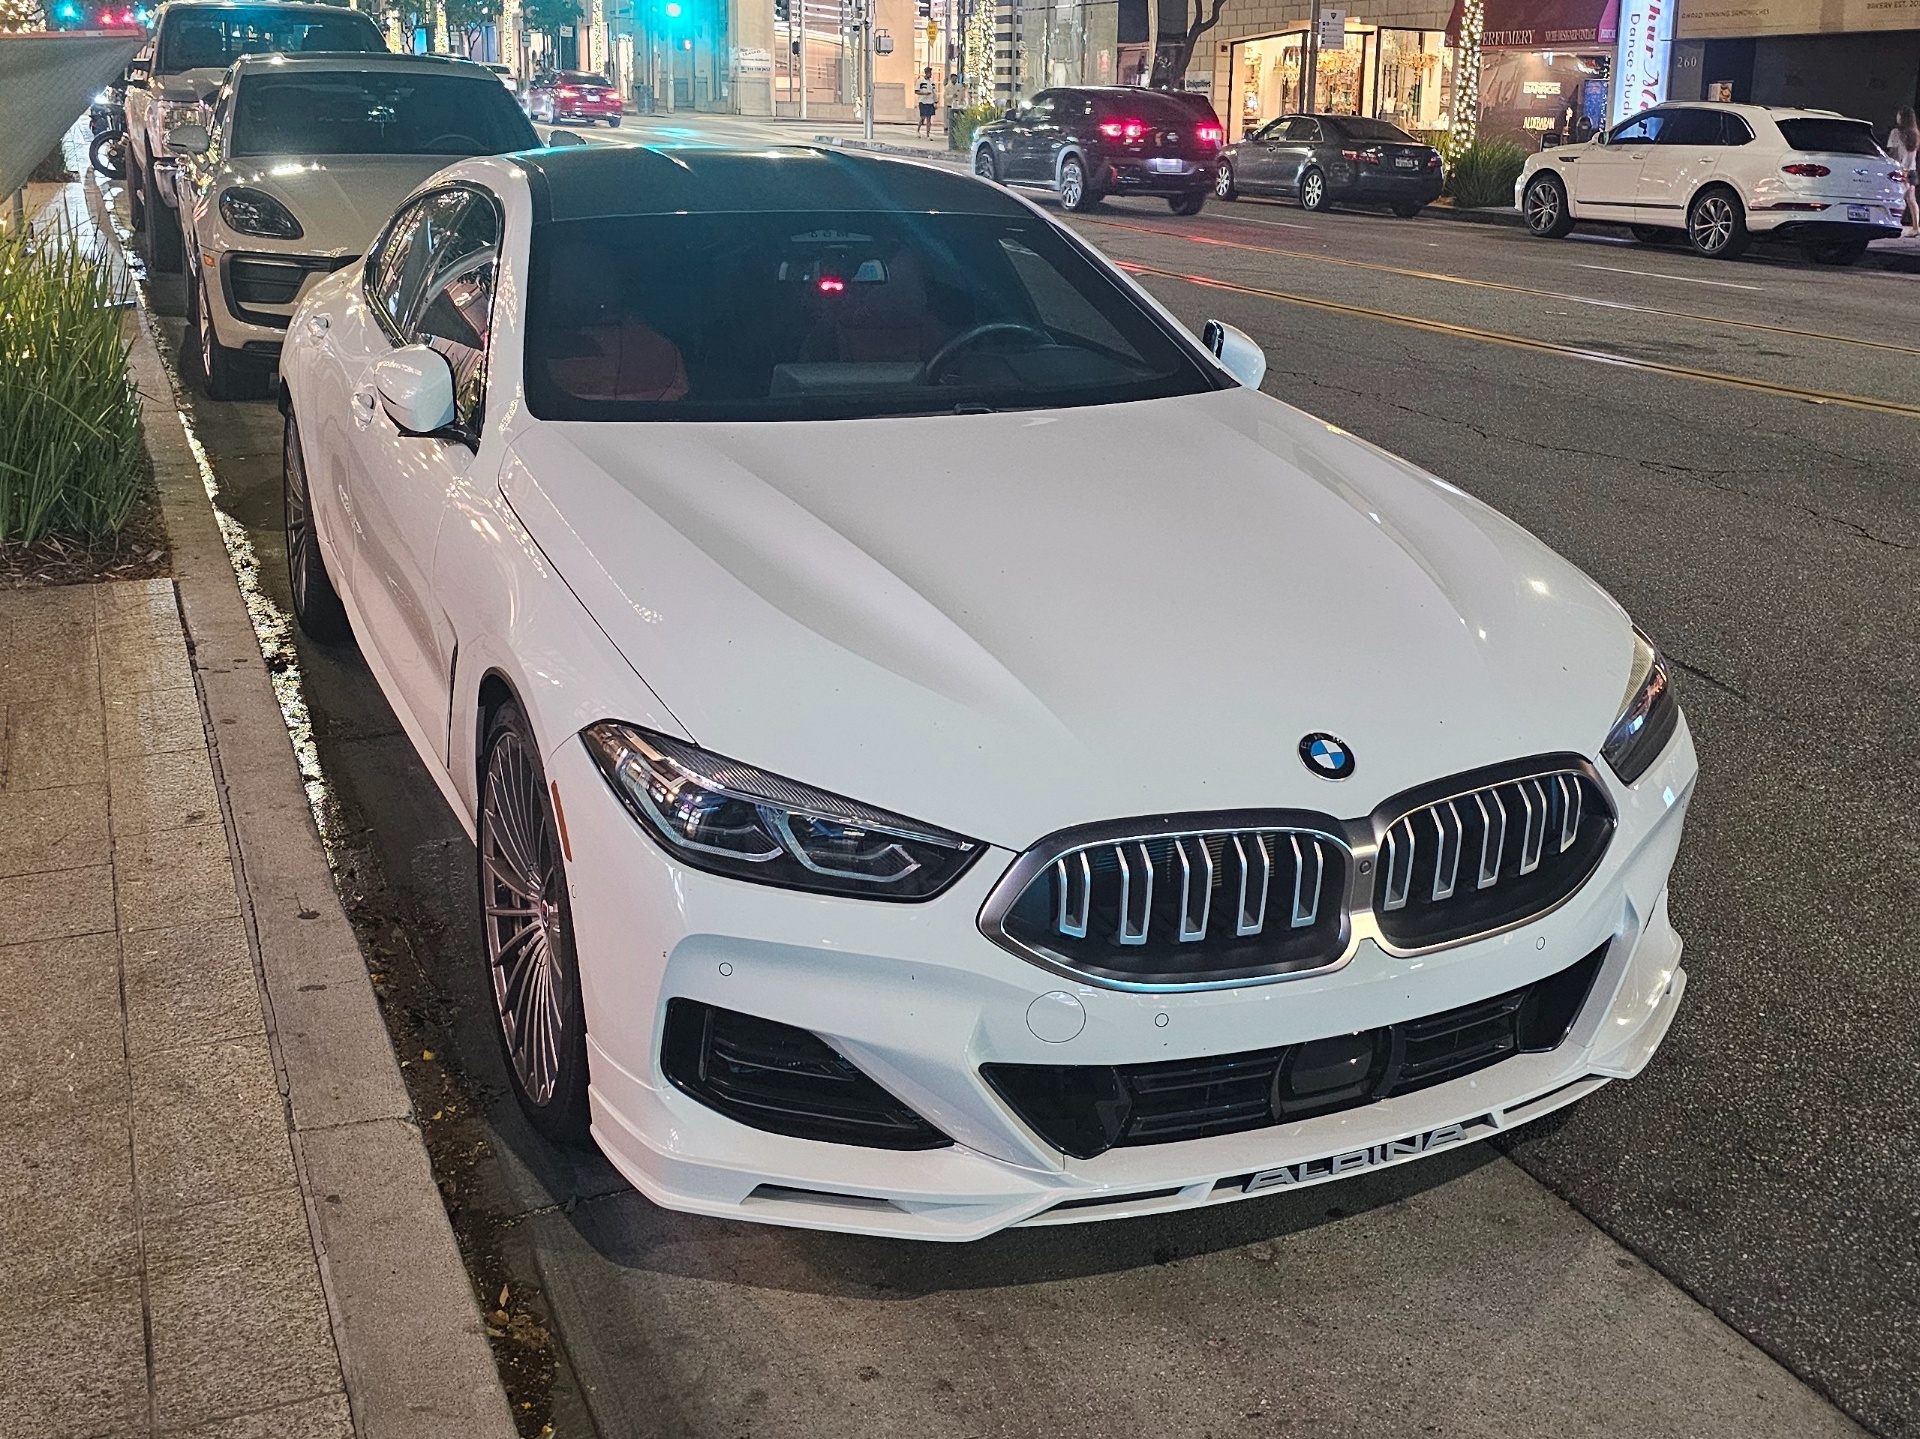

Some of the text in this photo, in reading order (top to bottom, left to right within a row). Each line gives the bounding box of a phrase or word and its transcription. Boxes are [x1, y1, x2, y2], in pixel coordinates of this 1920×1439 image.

[1622, 13, 1641, 117] Dance Studi
[1677, 56, 1697, 68] 260
[1243, 1123, 1468, 1194] ALPINA
